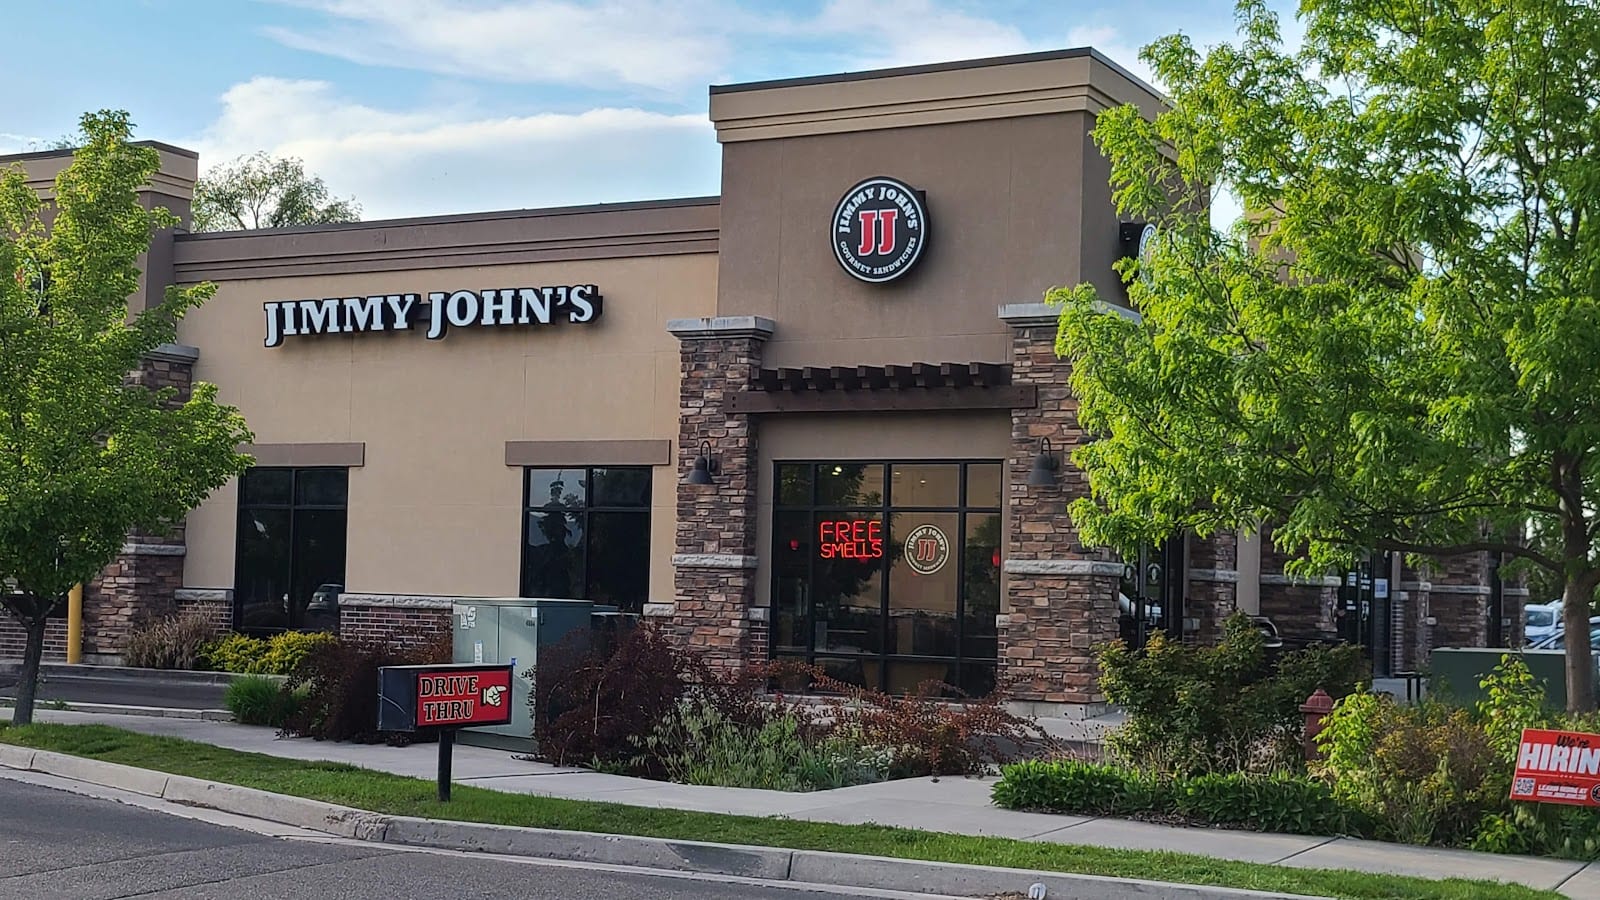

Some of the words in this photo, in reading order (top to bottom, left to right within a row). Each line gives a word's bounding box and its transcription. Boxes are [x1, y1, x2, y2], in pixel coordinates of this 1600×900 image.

[839, 188, 875, 233] JIMMY
[879, 187, 917, 229] JOHN'S
[858, 208, 898, 256] JJ
[840, 241, 872, 274] GOURMET
[873, 237, 916, 275] SANDWICHES
[264, 294, 415, 347] JIMMY
[426, 285, 595, 340] JOHN'S
[820, 520, 882, 542] FREE
[908, 528, 927, 549] JIMMY
[820, 542, 883, 559] SMELLS
[917, 538, 937, 562] JJ
[420, 675, 478, 697] DRIVE
[423, 700, 474, 722] THRU
[1557, 734, 1590, 749] We're
[1518, 742, 1600, 775] HIRIN
